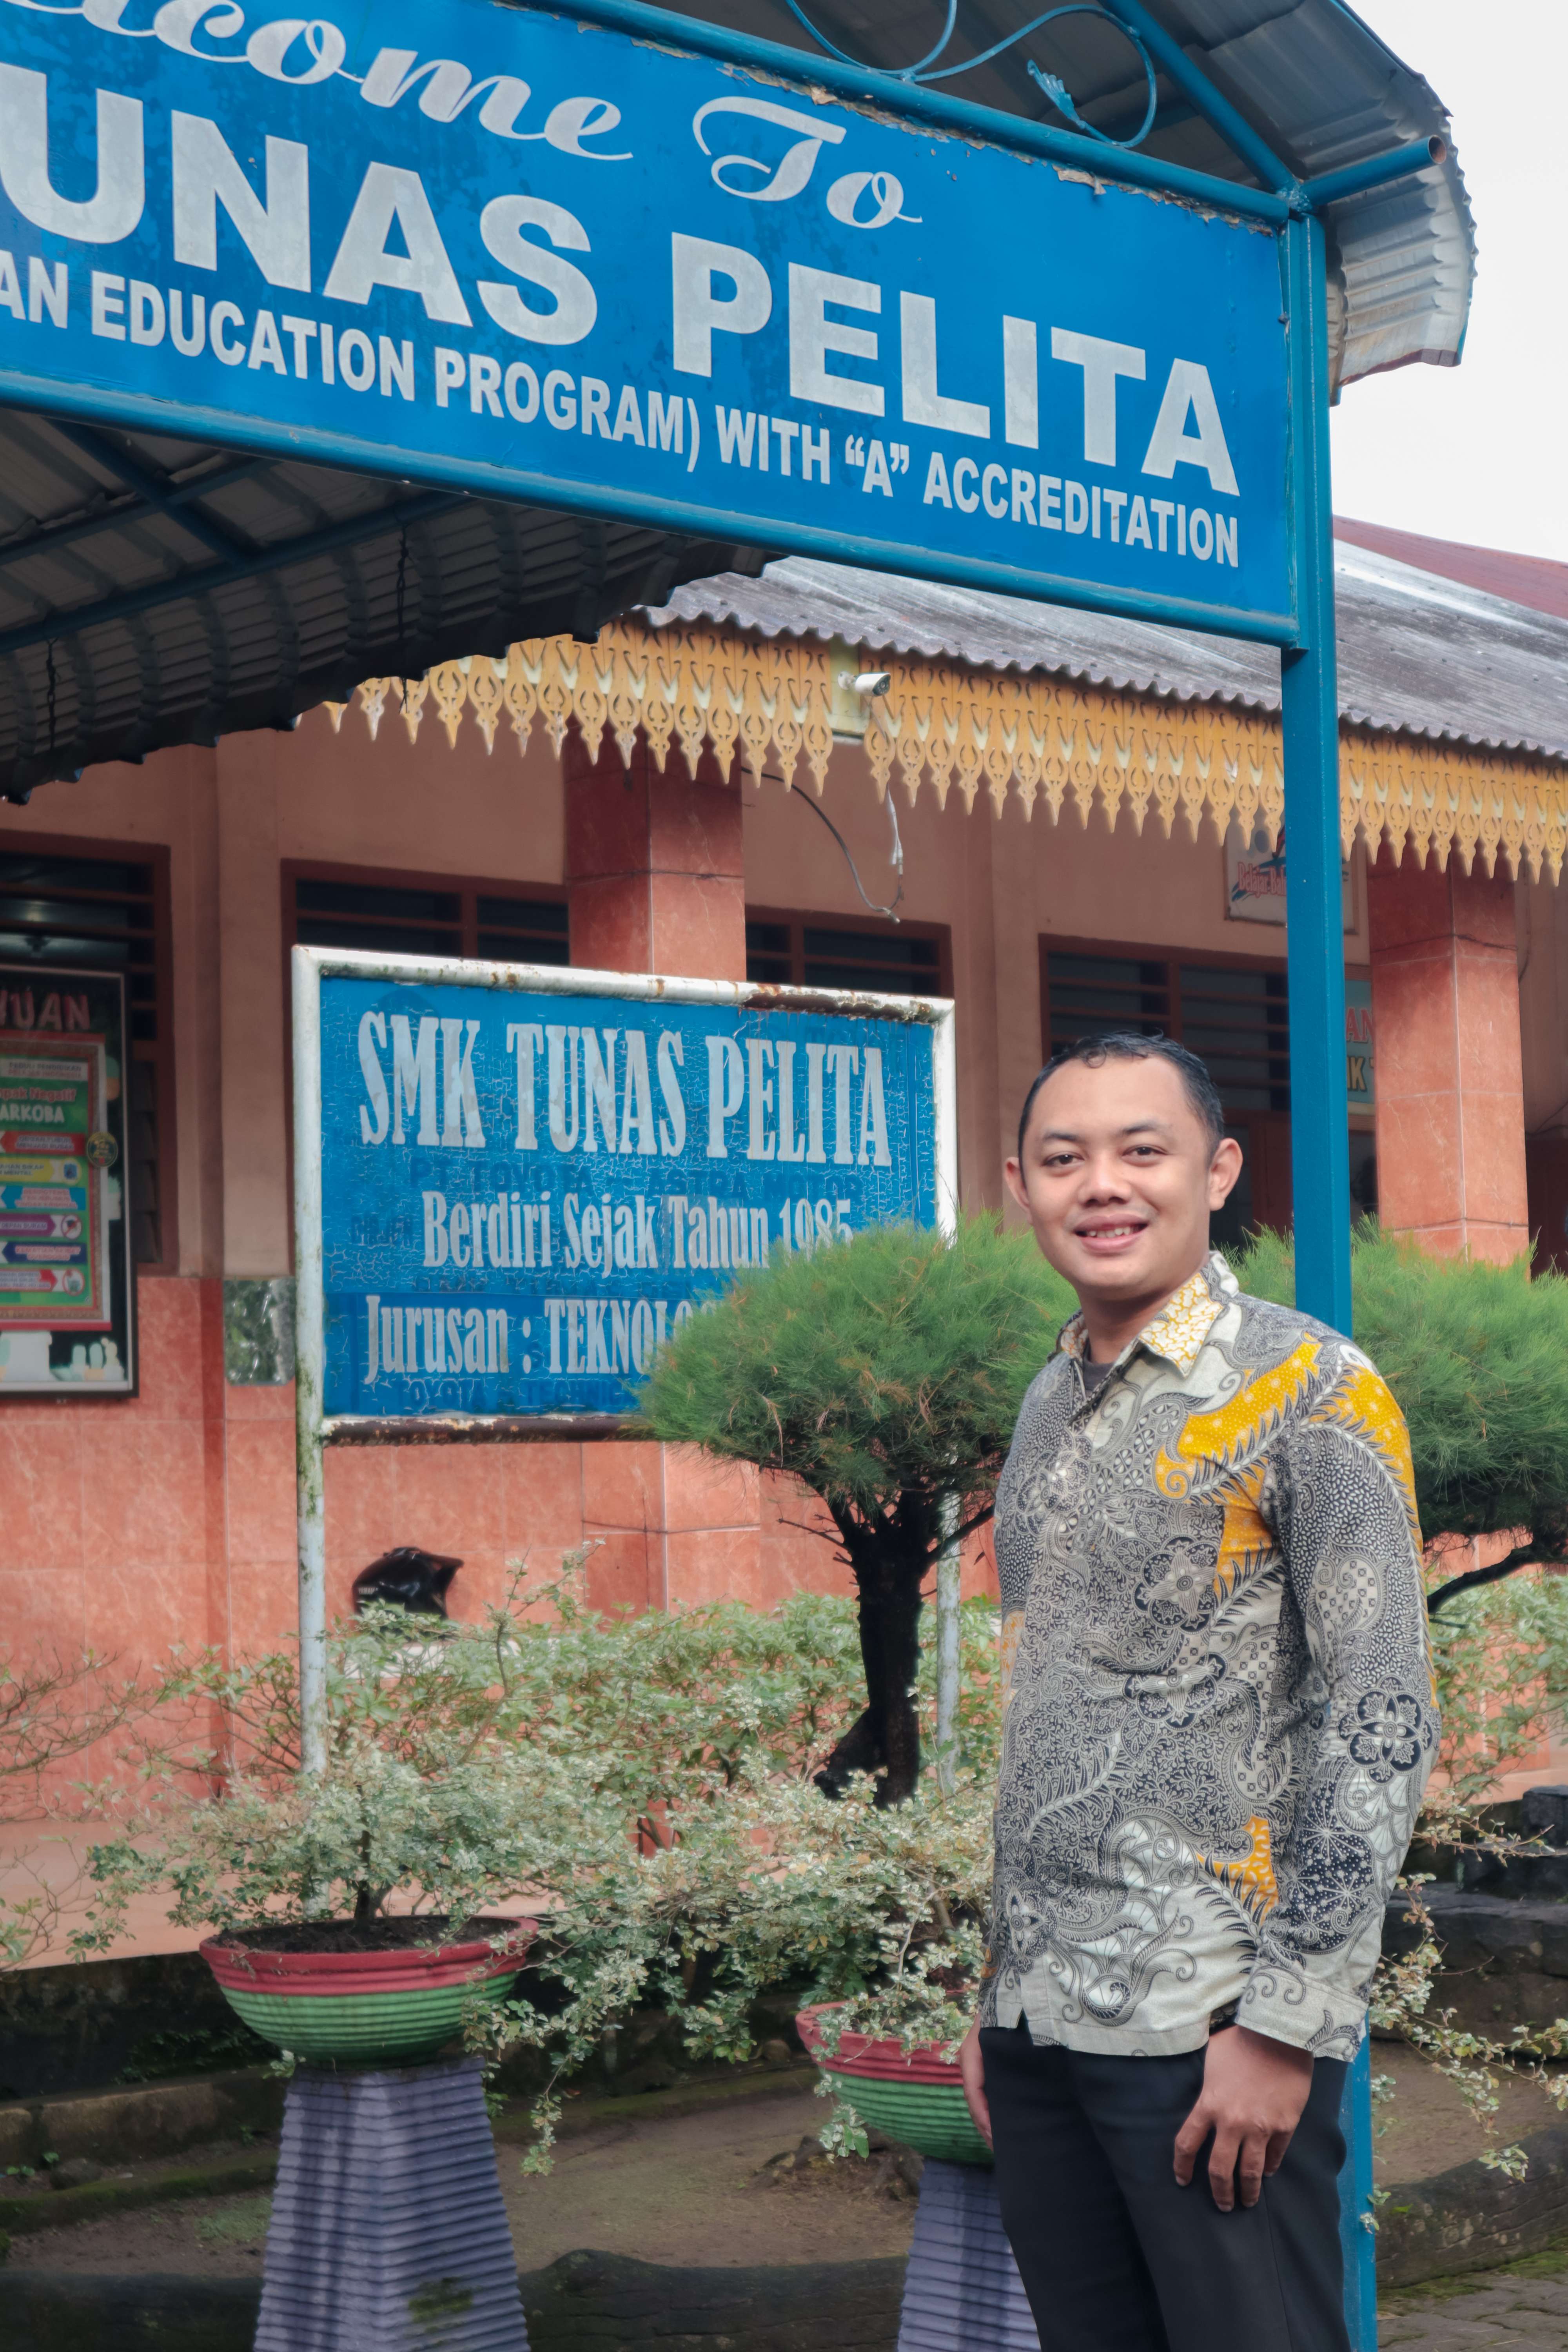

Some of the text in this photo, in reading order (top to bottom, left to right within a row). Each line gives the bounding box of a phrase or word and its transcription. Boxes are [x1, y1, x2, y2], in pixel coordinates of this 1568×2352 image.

[693, 96, 922, 229] To
[0, 62, 1240, 496] UNAS PELITA
[92, 270, 415, 401] EDUCATION
[435, 347, 700, 472] PROGRAM)
[716, 405, 830, 485] WITH
[924, 452, 1238, 568] ACCREDITATION
[358, 1011, 892, 1167] SMK TUNAS PELITA
[422, 1191, 552, 1268] Berdiri
[564, 1193, 659, 1278] Sejak
[667, 1195, 770, 1269] Tahun
[365, 1295, 717, 1385] Jurusan : TEKNOL
